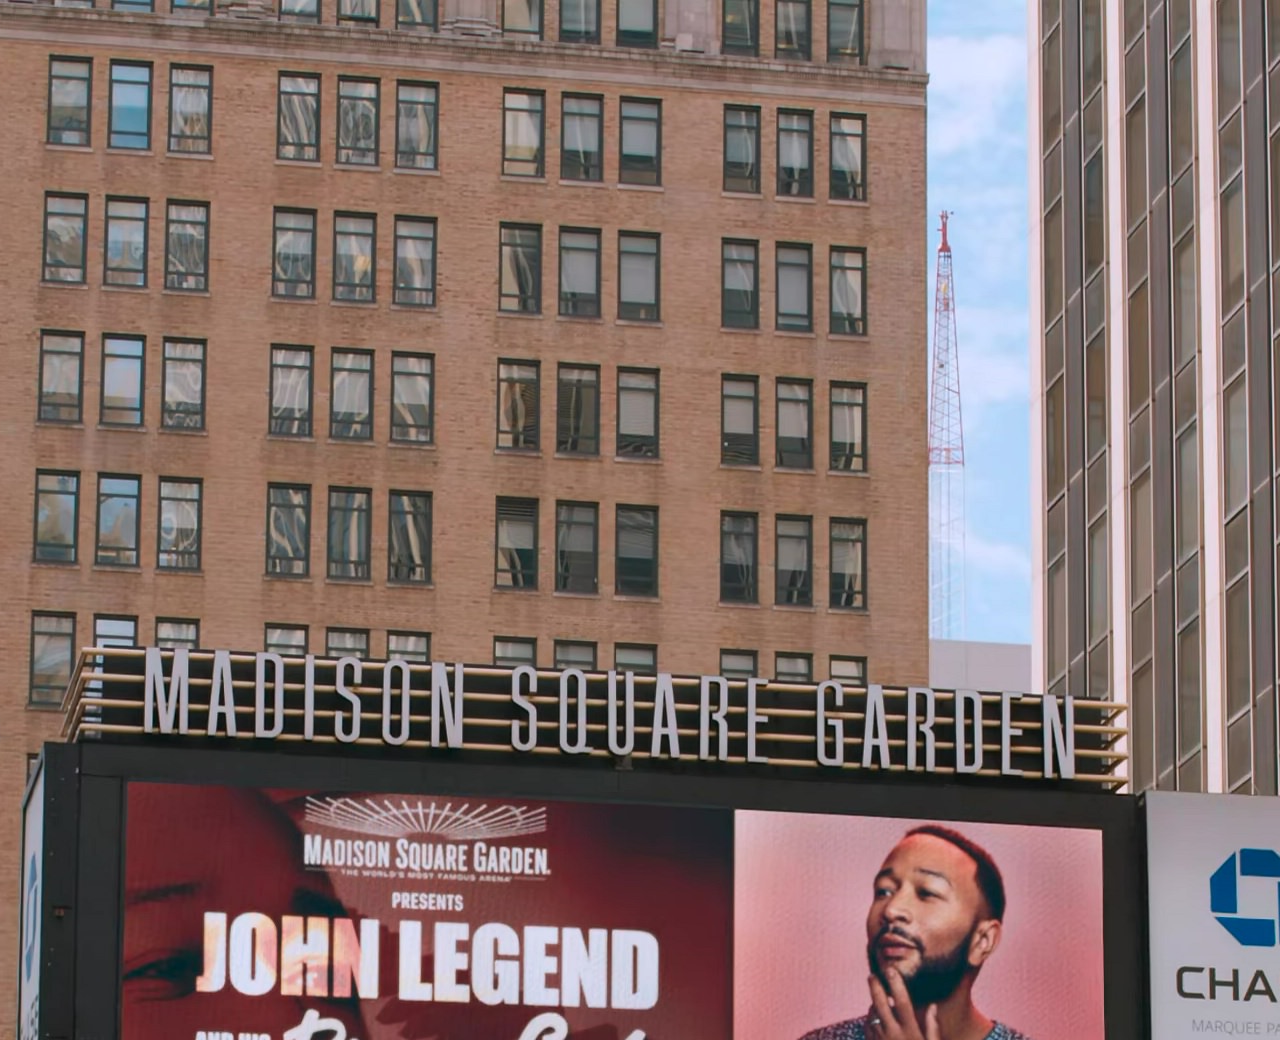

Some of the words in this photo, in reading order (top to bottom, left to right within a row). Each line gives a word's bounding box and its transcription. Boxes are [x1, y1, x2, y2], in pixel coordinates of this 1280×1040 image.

[143, 647, 465, 750] MADISON
[510, 665, 770, 765] SQUARE
[816, 679, 1076, 780] GARDEN
[303, 834, 390, 867] MADISON
[395, 838, 469, 872] SQUARE
[362, 870, 405, 879] WORLD'S
[407, 872, 434, 880] MOST
[437, 873, 476, 882] FAMOUS
[391, 891, 464, 911] PRESENTS
[195, 911, 380, 999] JOHN
[398, 919, 660, 1010] LEGEND
[1191, 1018, 1261, 1036] MARQUEE
